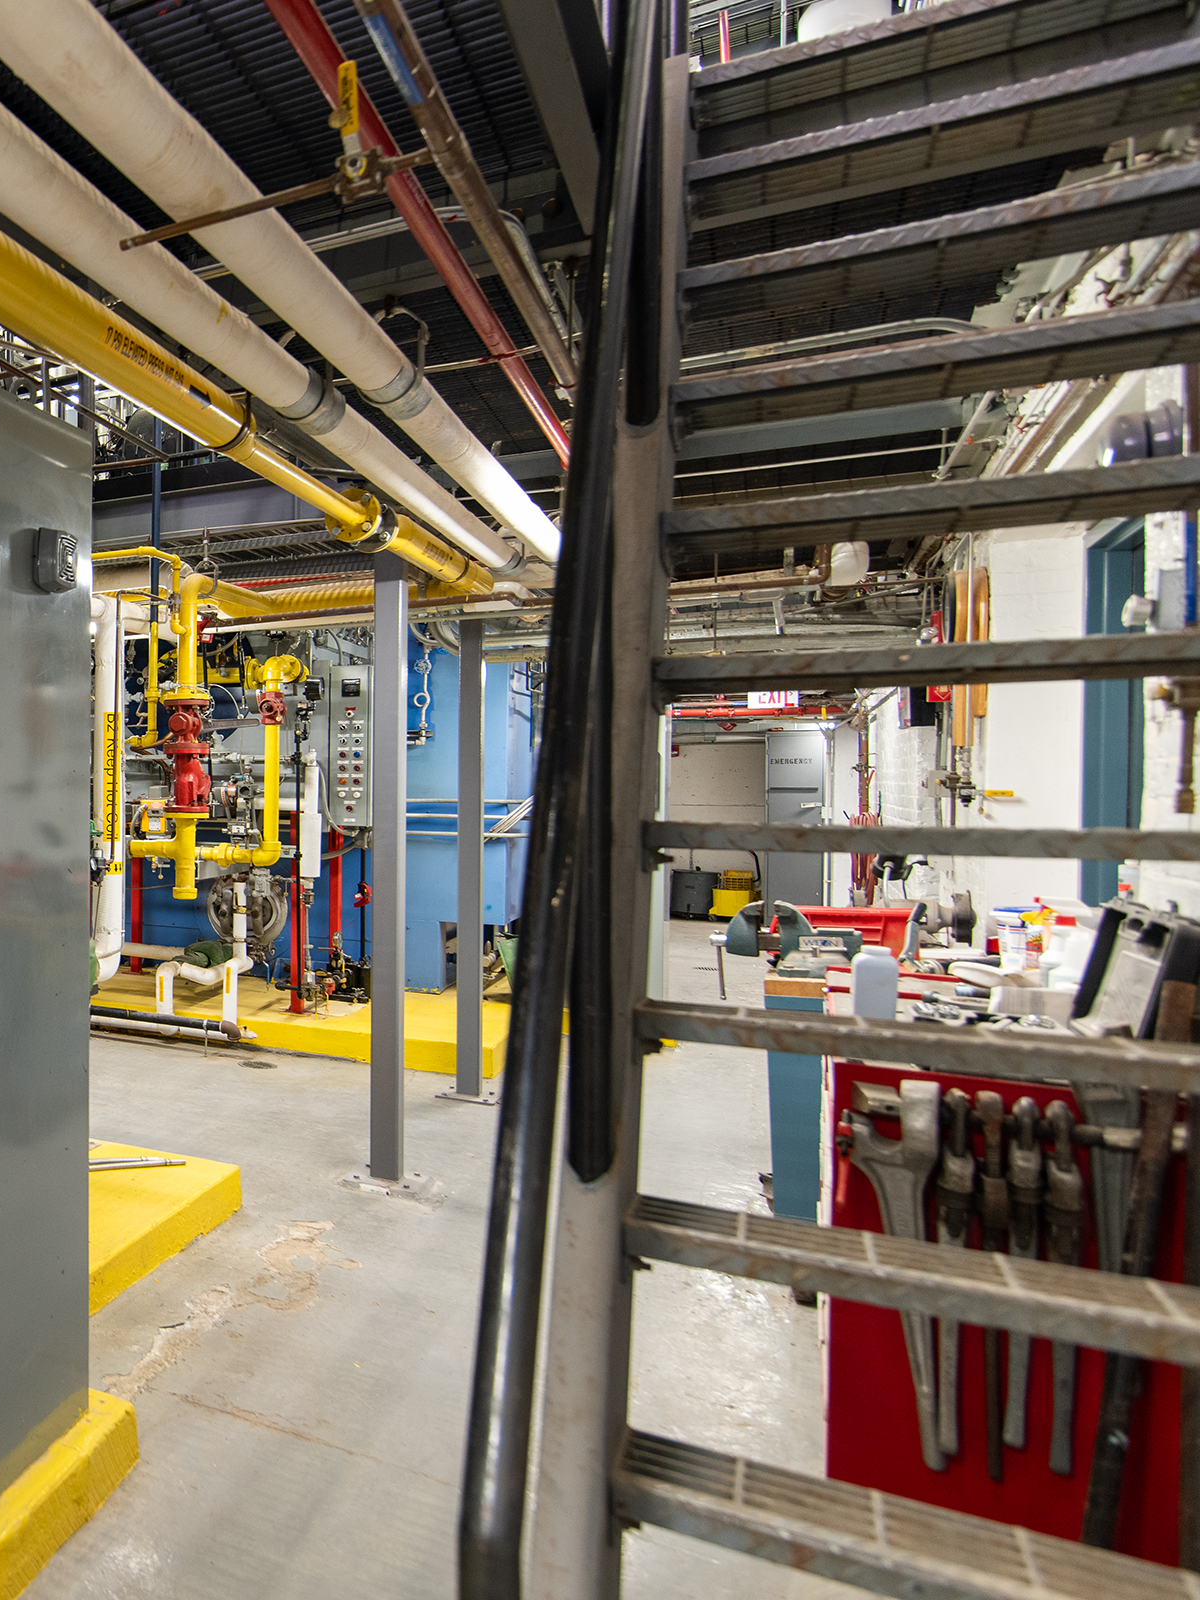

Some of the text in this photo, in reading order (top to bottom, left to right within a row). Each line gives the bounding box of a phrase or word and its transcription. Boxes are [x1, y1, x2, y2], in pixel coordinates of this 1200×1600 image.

[111, 329, 124, 351] PSI
[120, 336, 148, 367] ELEVATED
[145, 353, 165, 378] PRESS
[103, 713, 119, 839] B2 Keep Hot Coil
